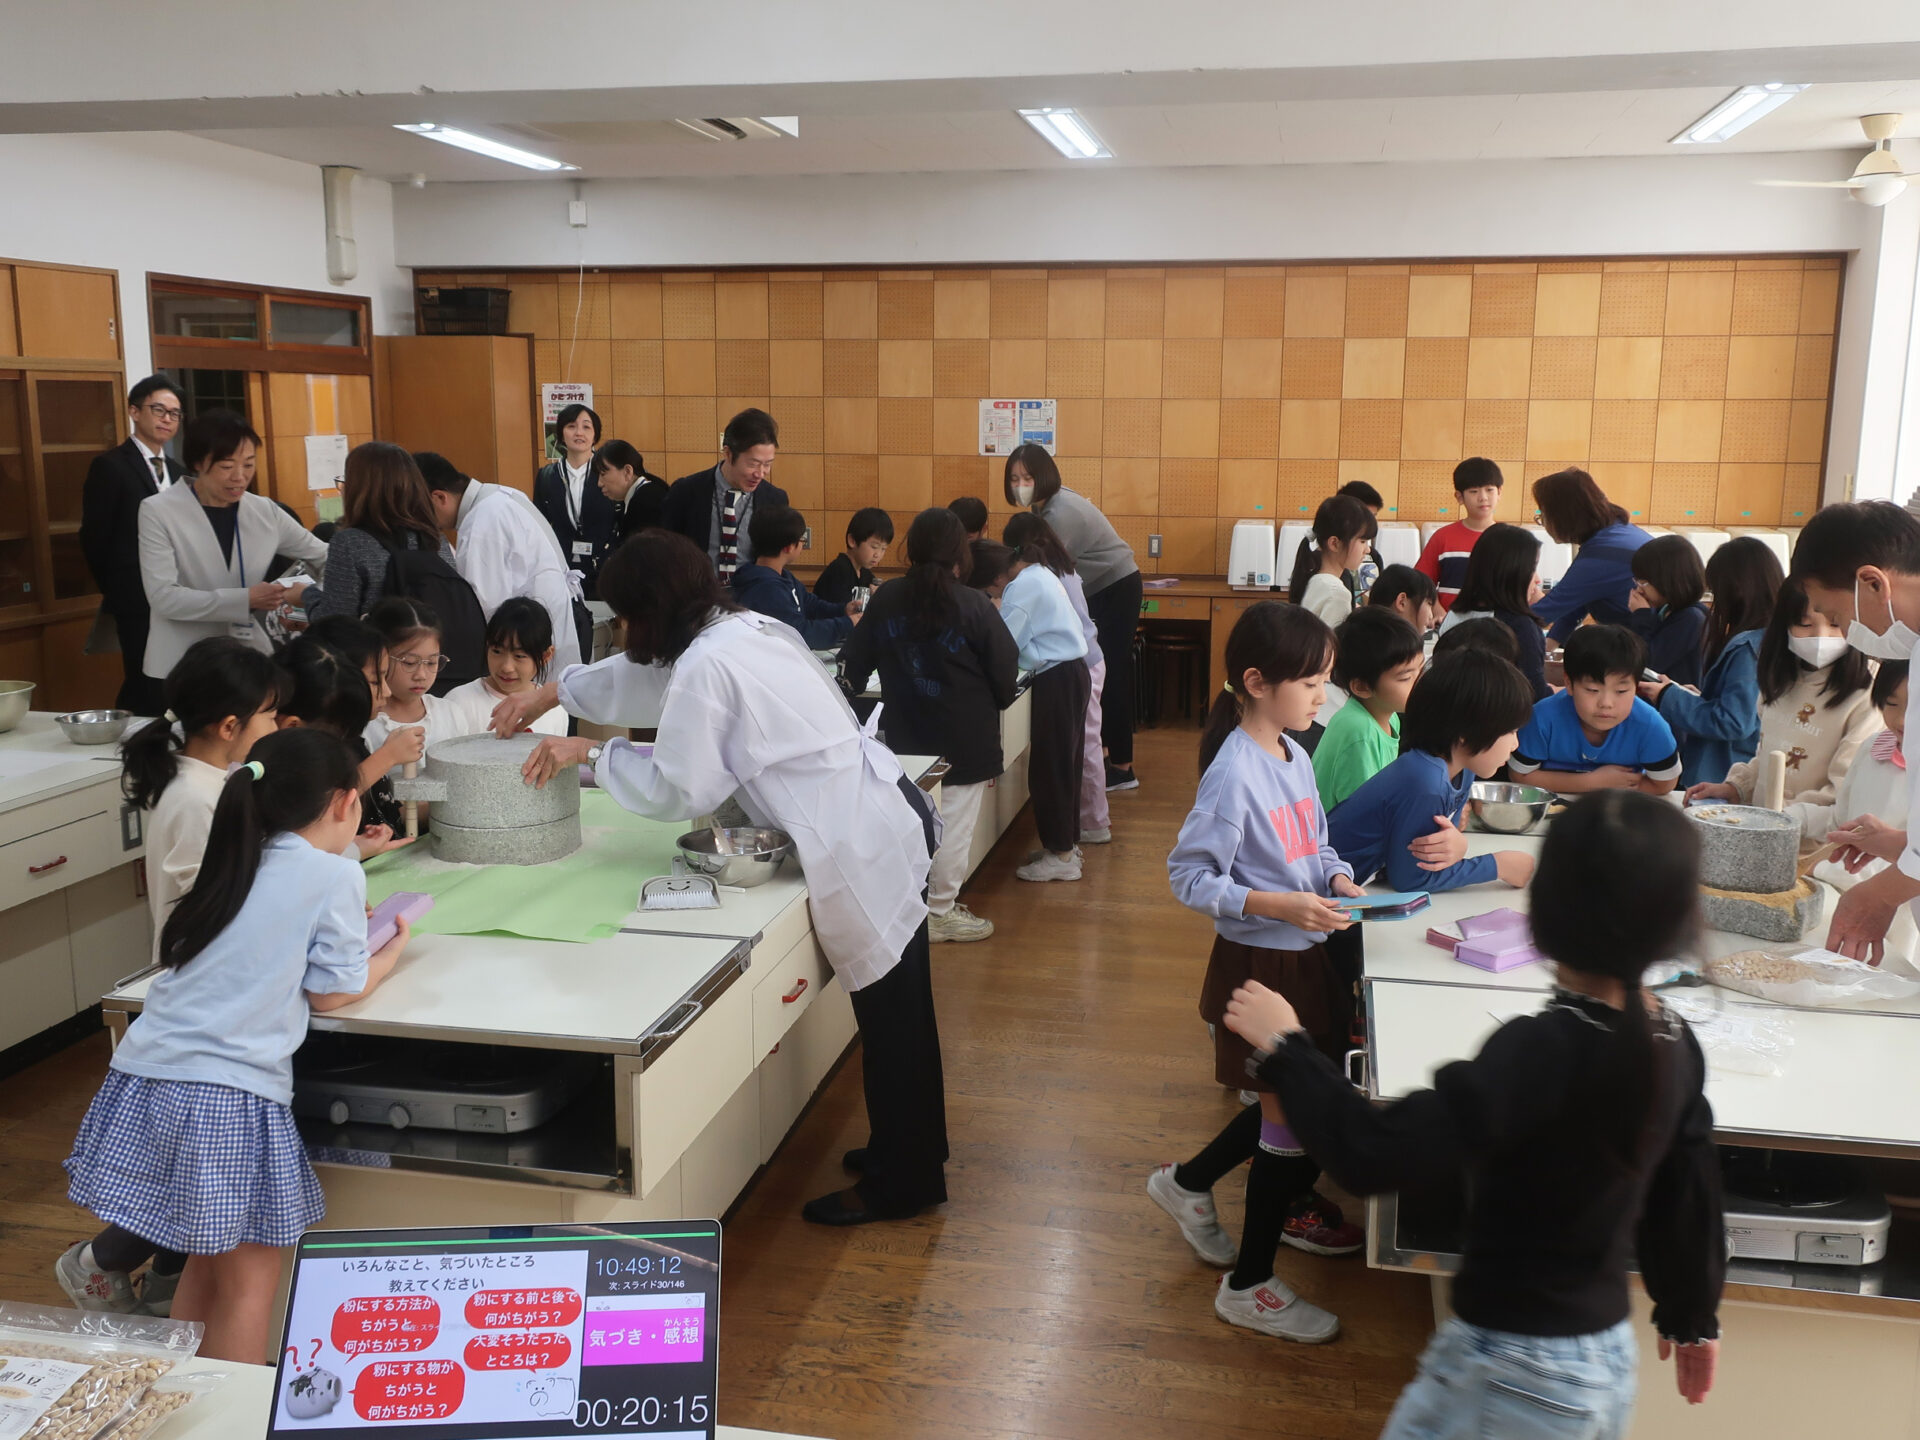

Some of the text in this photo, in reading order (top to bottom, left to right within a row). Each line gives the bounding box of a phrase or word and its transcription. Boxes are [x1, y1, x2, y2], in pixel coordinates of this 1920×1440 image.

[342, 1254, 535, 1273] いろんなこと、気づいたところ
[595, 1256, 682, 1276] 10:49:12
[388, 1277, 485, 1294] 教えてください
[622, 1280, 685, 1289] スライド30/146
[342, 1298, 436, 1314] 粉にする方法が
[473, 1290, 578, 1306] 粉にする前と後で
[360, 1319, 412, 1332] ちがうと
[663, 1317, 700, 1327] かんそう
[473, 1333, 566, 1349] 大変そうだった
[373, 1360, 454, 1378] 粉にする物が
[384, 1382, 438, 1398] ちがうと
[572, 1395, 710, 1428] 00:20:15
